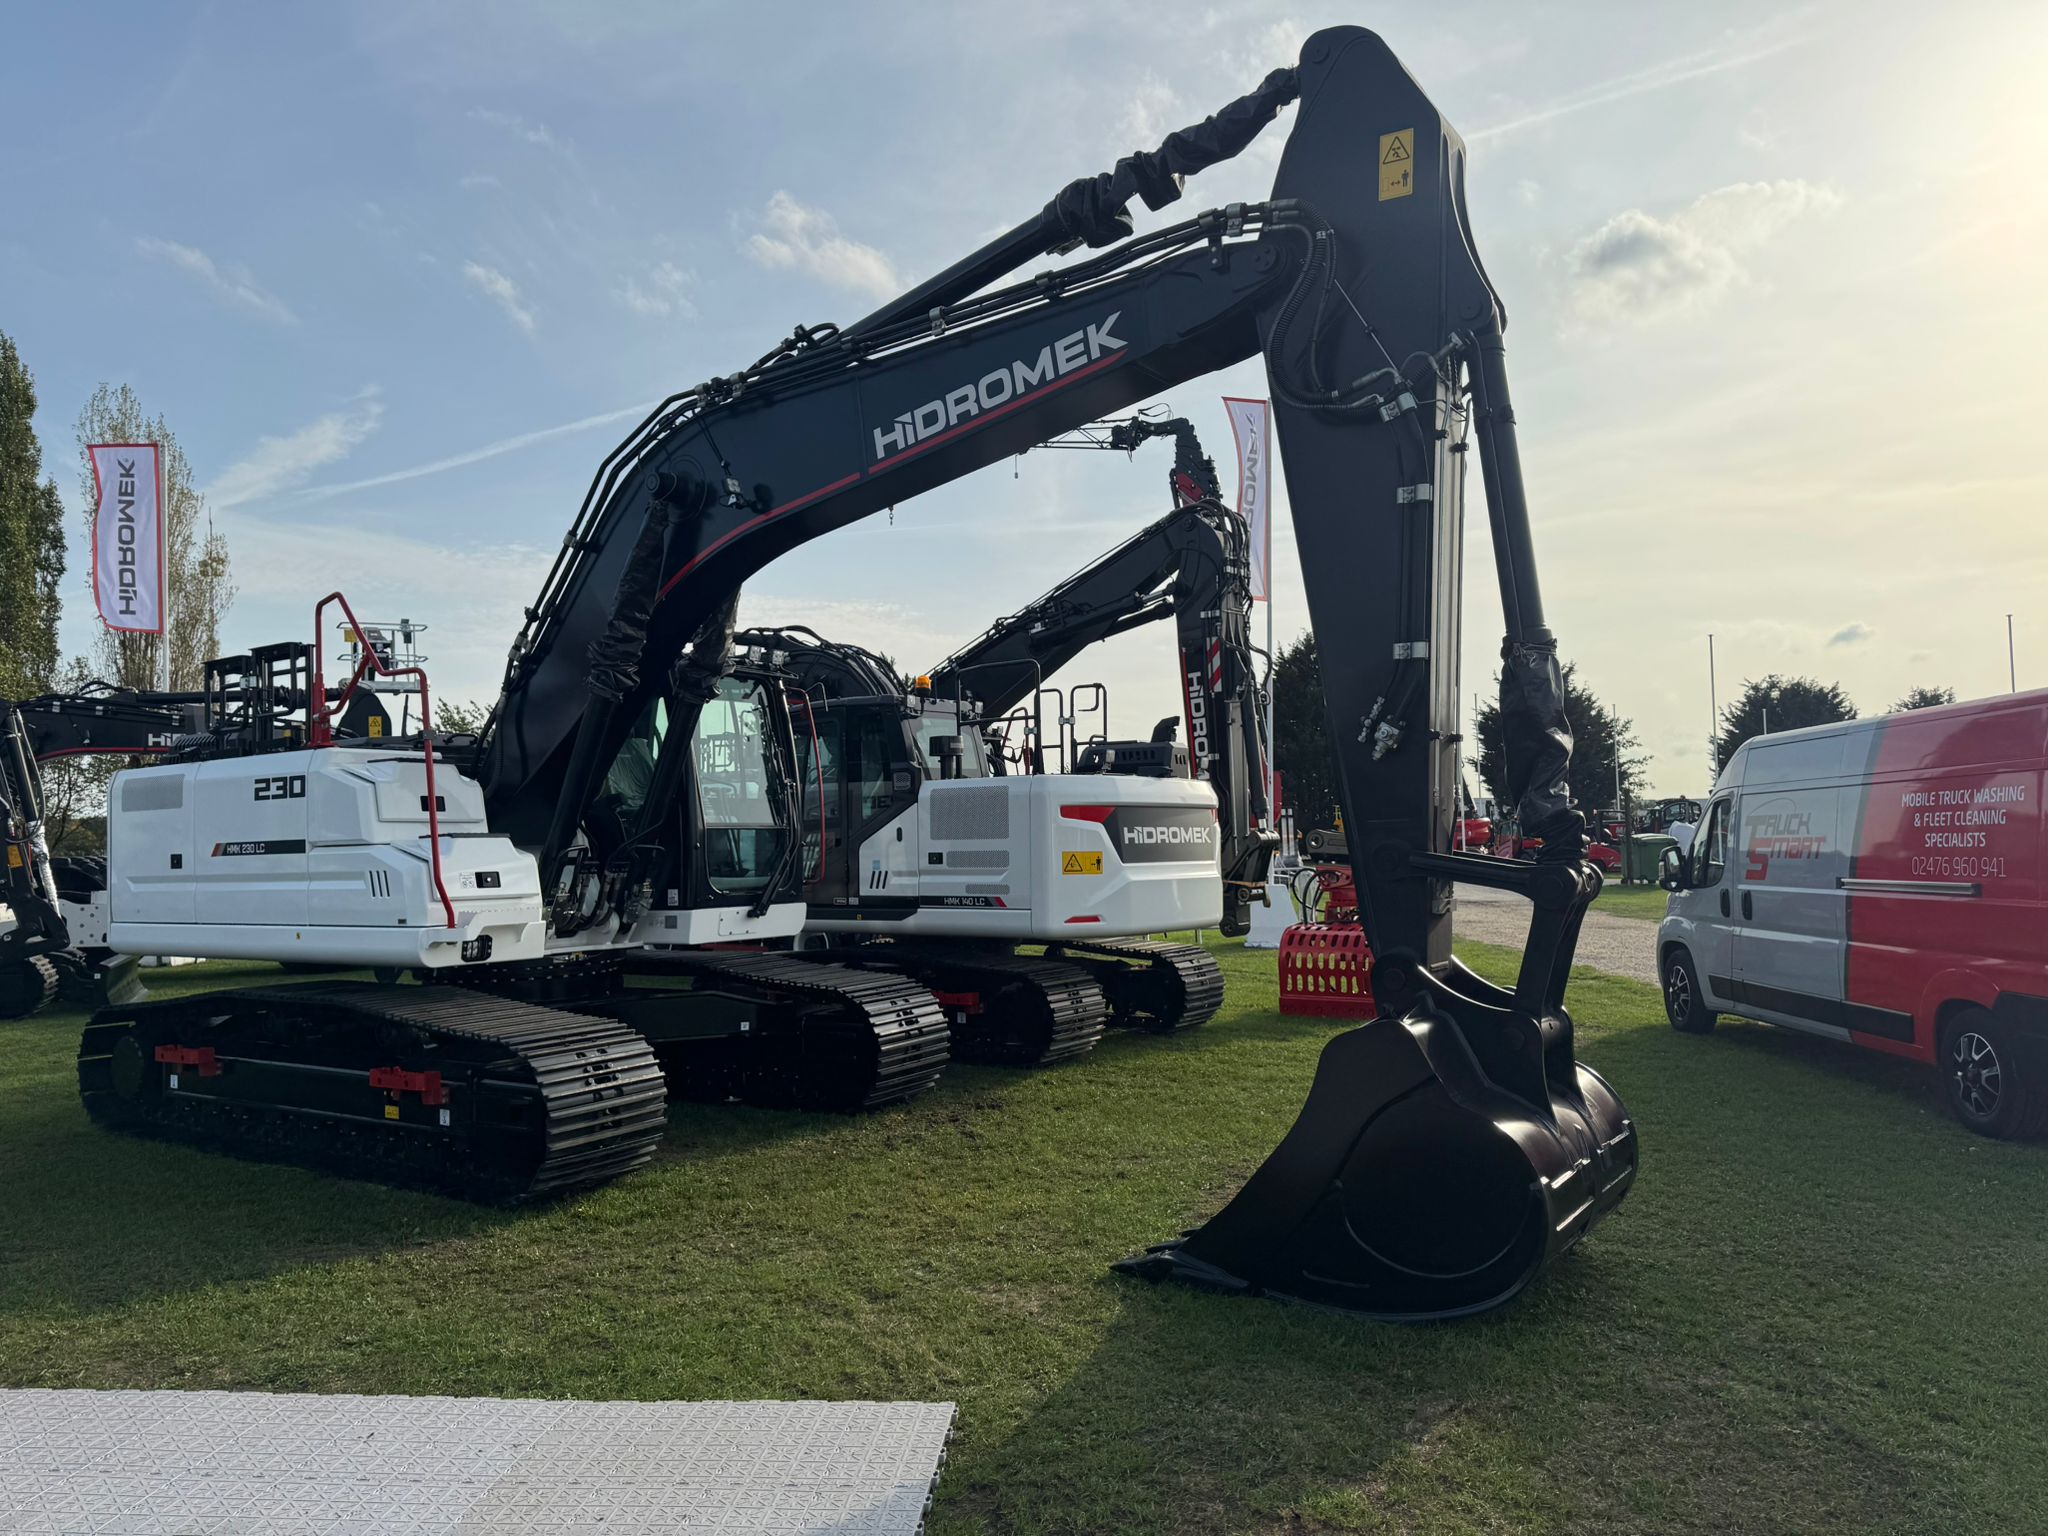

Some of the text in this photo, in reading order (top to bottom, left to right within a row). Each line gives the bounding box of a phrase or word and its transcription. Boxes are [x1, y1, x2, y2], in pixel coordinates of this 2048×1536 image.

[254, 775, 306, 801] 230
[1902, 786, 2025, 807] MOBILE TRUCK WASHING
[1914, 809, 2006, 827] & FLEET CLEANING
[226, 843, 265, 854] HMK 230 LC
[1925, 832, 1986, 847] SPECIALISTS
[1912, 856, 2007, 878] 02476 960 941
[944, 897, 960, 905] HMK
